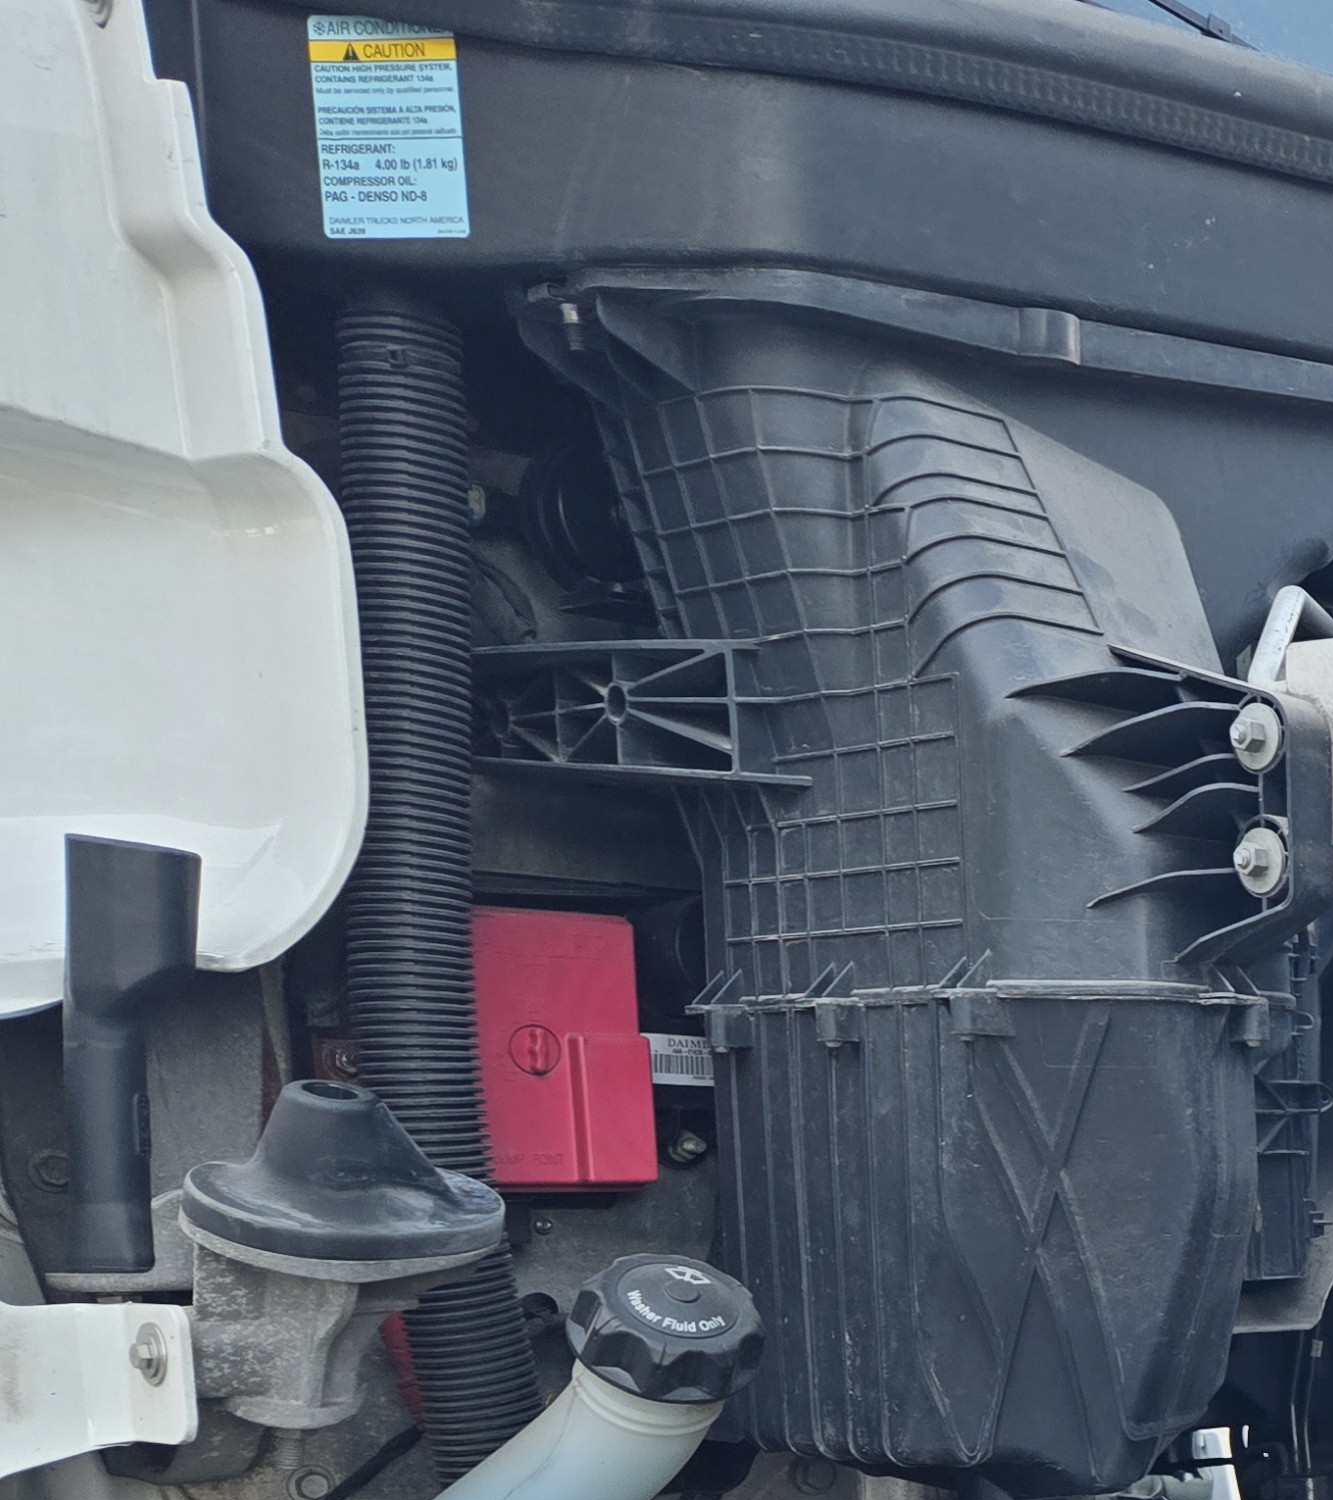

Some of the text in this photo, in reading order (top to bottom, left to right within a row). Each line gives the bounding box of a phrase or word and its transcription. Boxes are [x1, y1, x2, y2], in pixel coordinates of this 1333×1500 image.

[327, 21, 349, 35] AIR
[363, 43, 425, 58] CAUTION
[314, 65, 350, 73] CAUTION
[352, 64, 372, 72] HIGH
[374, 64, 417, 72] PRESSURE
[315, 75, 356, 83] CONTAINS
[358, 75, 414, 83] REFRIGERANT
[366, 106, 396, 114] SISTEMA
[318, 117, 355, 125] CONTIENE
[357, 117, 411, 125] REFRIGERANTE
[321, 144, 396, 154] REFRIGERANT:
[322, 158, 458, 172] R-134a 4.00 lb (1.81 kg)
[323, 176, 418, 186] COMPRESSOR OIL:
[325, 191, 349, 202] PAG
[358, 190, 398, 202] DENSO
[401, 190, 428, 202] ND-8
[329, 217, 365, 225] DAIMLER
[366, 217, 398, 225] TRUCKS
[429, 216, 465, 224] AMERICA
[626, 1289, 726, 1333] Washer Fluid Only
